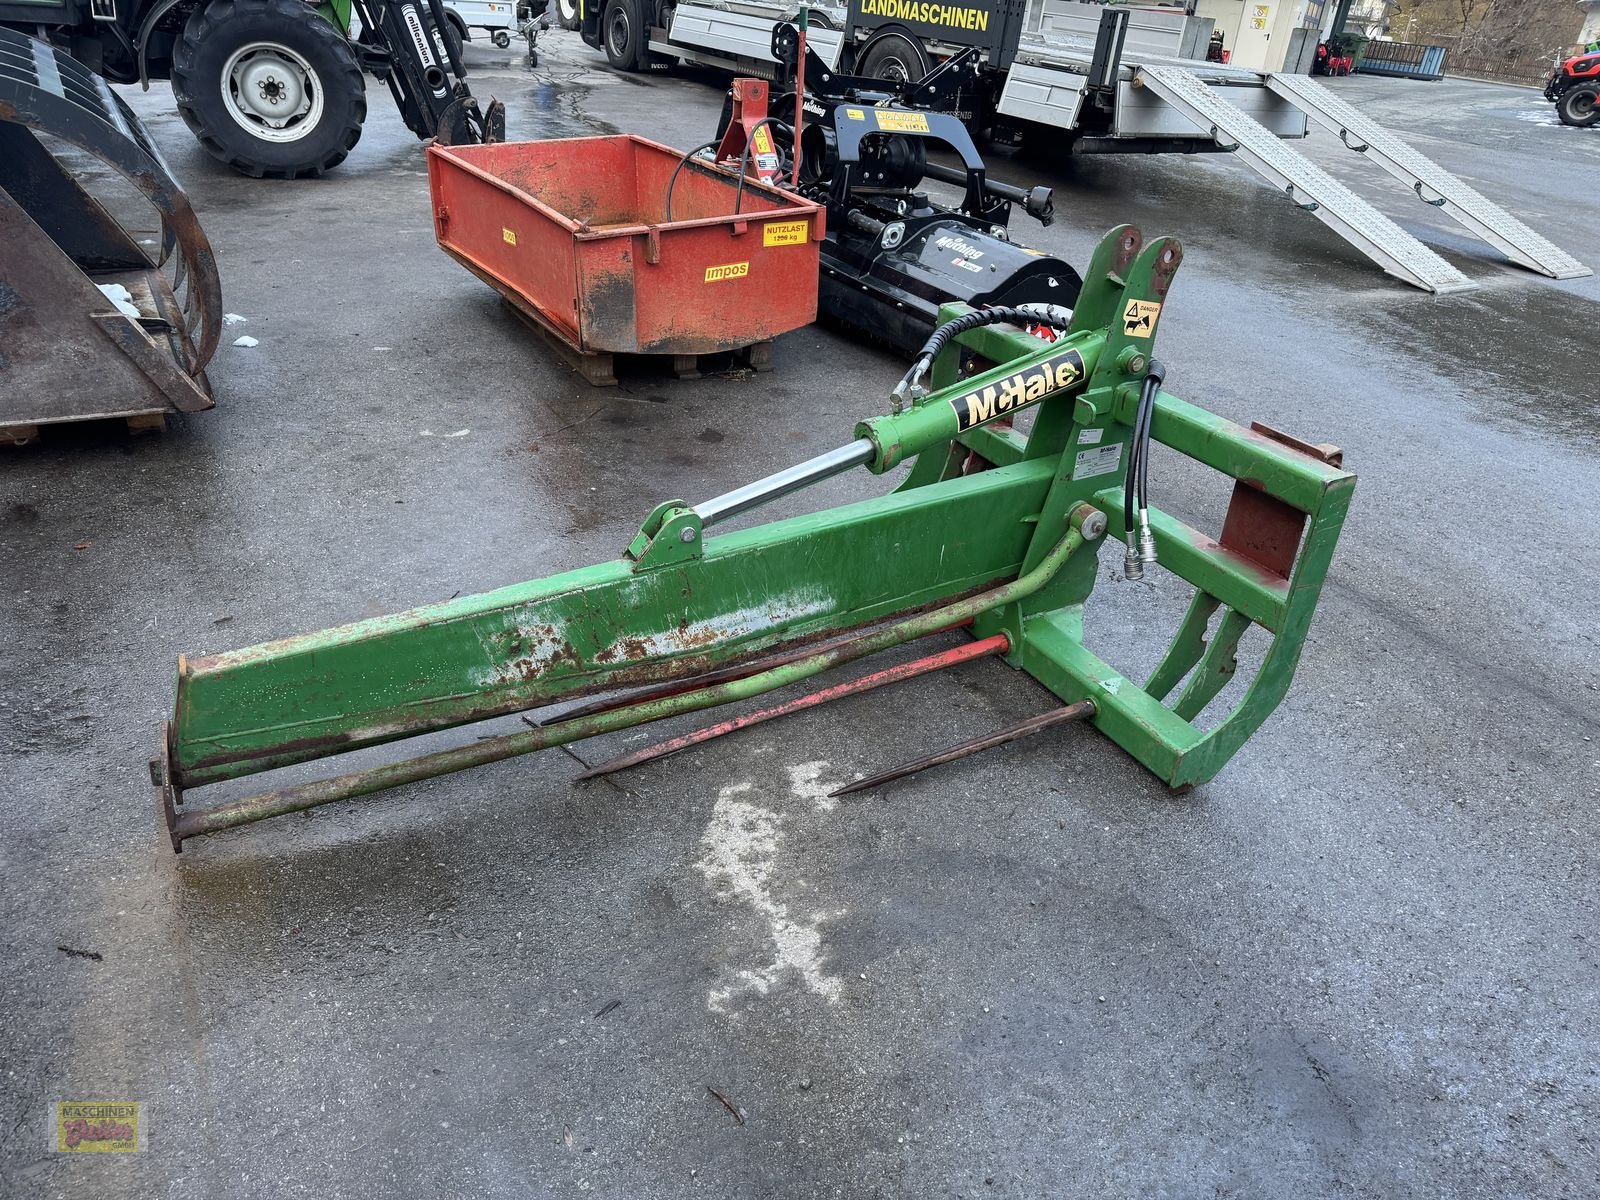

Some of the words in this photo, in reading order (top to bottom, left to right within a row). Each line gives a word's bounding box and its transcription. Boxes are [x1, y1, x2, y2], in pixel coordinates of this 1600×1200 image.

[861, 0, 988, 31] LANDMASCHINEN
[408, 16, 430, 64] millennium
[767, 225, 805, 234] NUTZLAST
[935, 236, 984, 260] Müthing
[707, 264, 747, 279] impos
[1140, 305, 1158, 313] DANGER
[965, 361, 1080, 426] McHale
